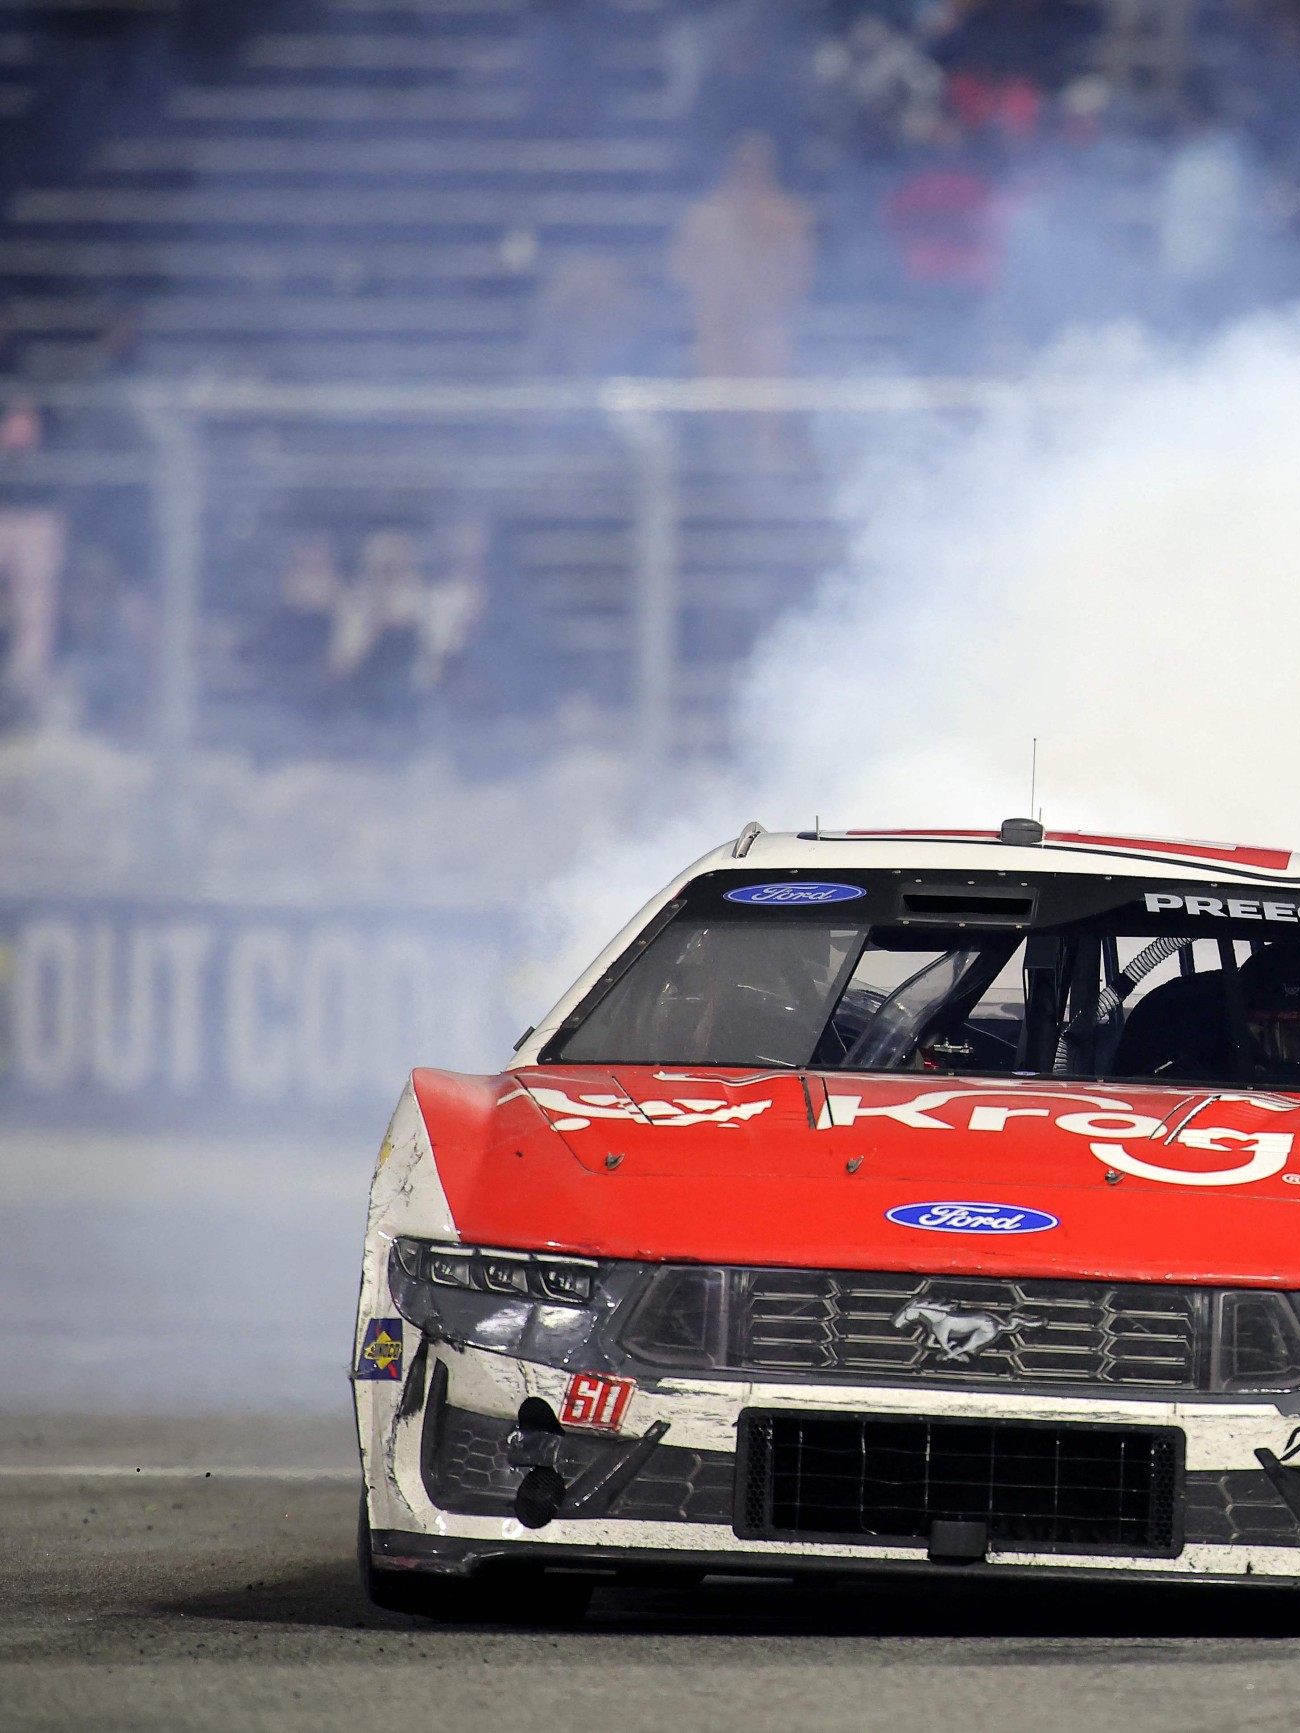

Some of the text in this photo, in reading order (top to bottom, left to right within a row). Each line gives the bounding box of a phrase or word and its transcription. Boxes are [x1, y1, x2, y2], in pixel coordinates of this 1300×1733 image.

[750, 885, 838, 901] Ford
[917, 1204, 1026, 1230] Ford
[561, 1371, 632, 1431] 60
